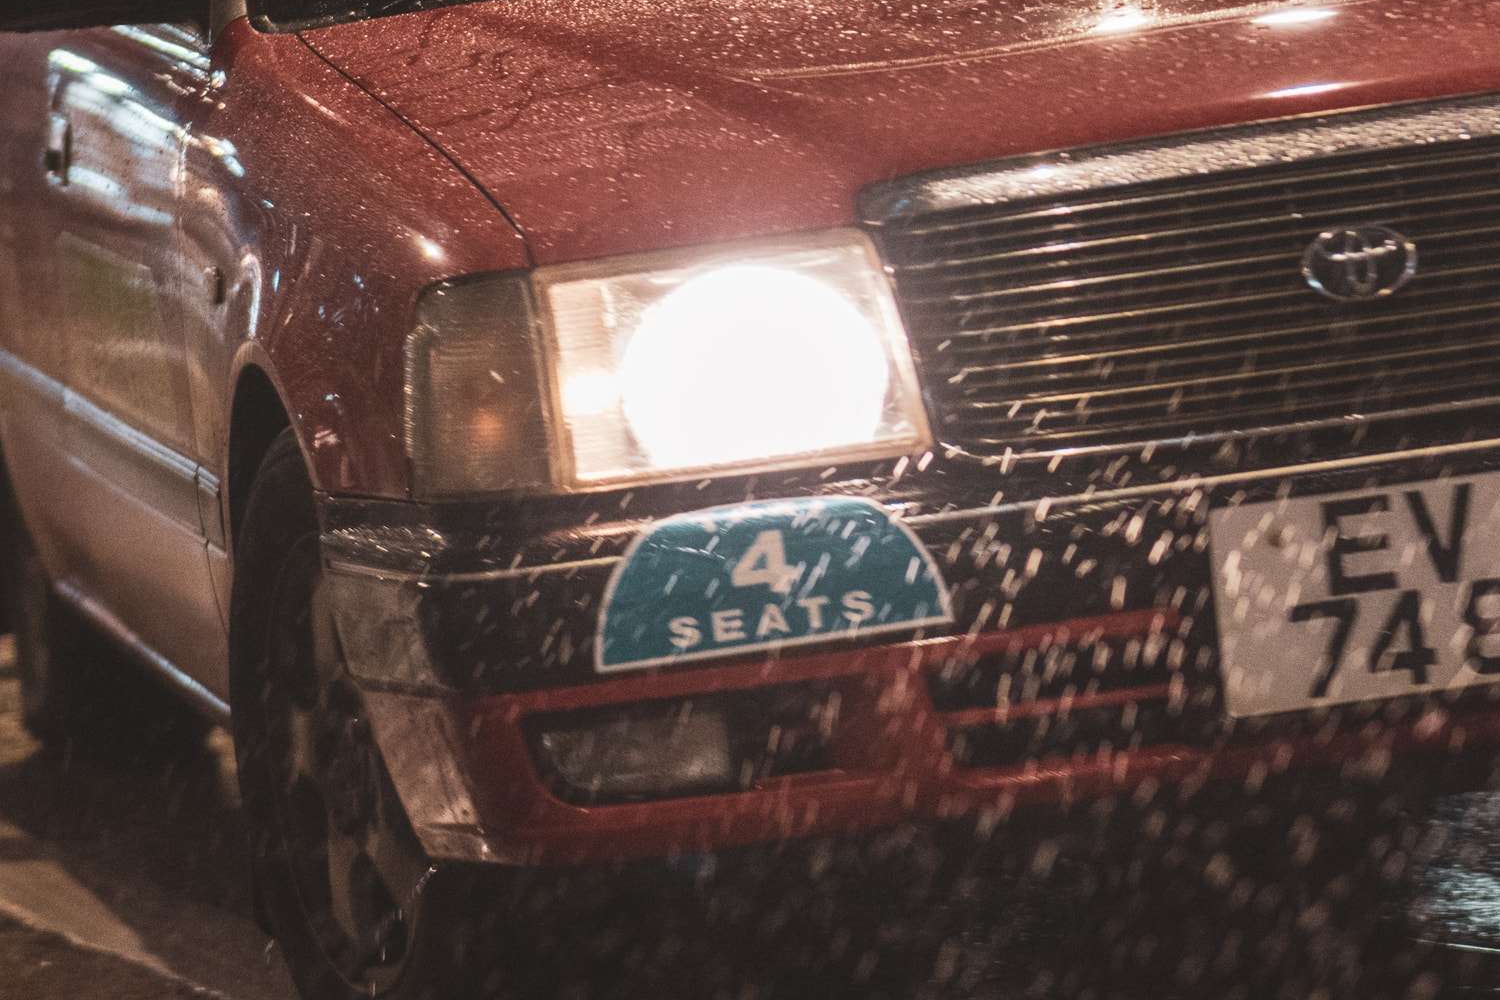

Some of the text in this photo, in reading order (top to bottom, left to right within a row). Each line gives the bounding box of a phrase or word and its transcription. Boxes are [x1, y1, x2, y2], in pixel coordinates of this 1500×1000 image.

[731, 530, 800, 593] 4
[1319, 483, 1474, 597] EV
[668, 590, 876, 647] SEATS
